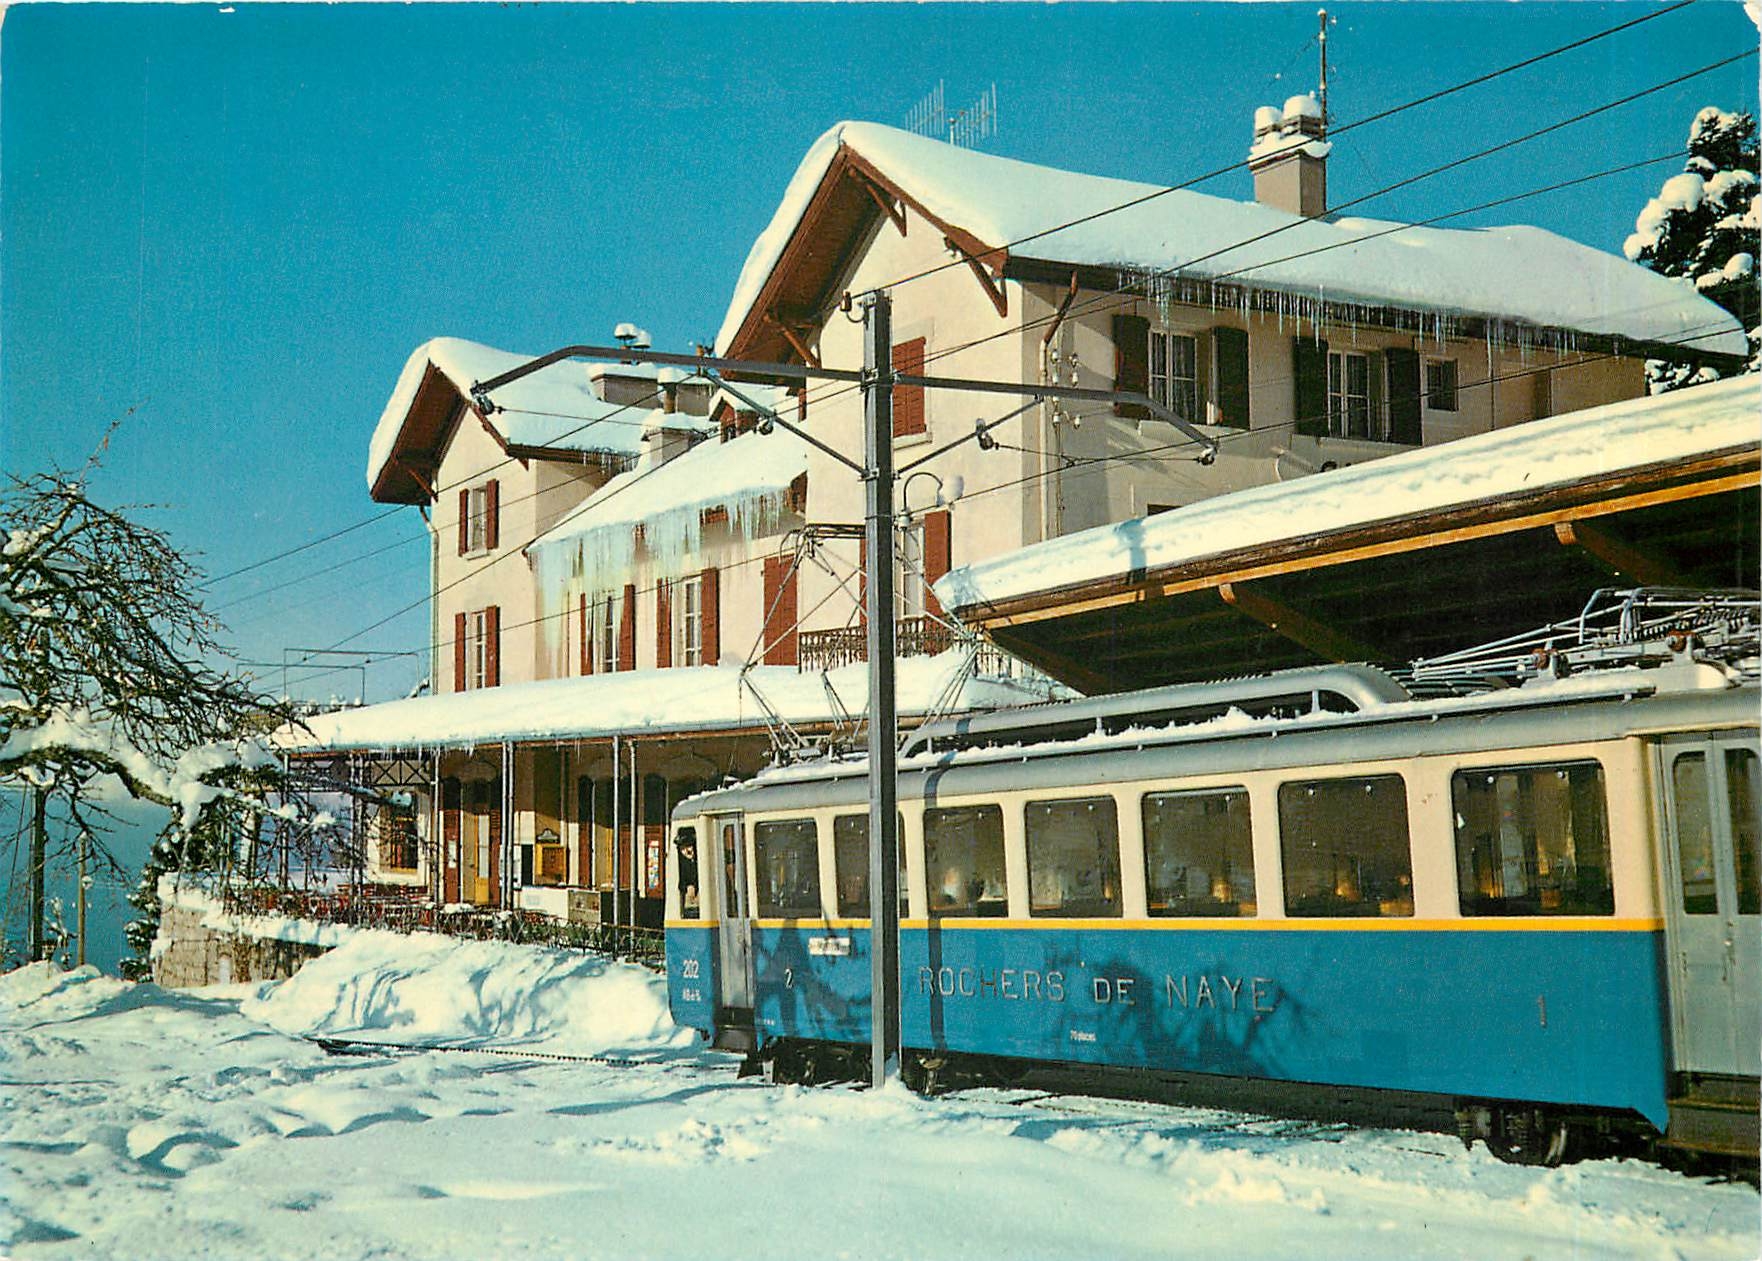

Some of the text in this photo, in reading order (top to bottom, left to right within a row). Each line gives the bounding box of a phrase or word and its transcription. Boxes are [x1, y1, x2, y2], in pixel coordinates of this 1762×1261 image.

[683, 960, 699, 978] 202
[784, 967, 793, 989] 2
[919, 967, 1275, 1012] ROCHERS DE NAYE
